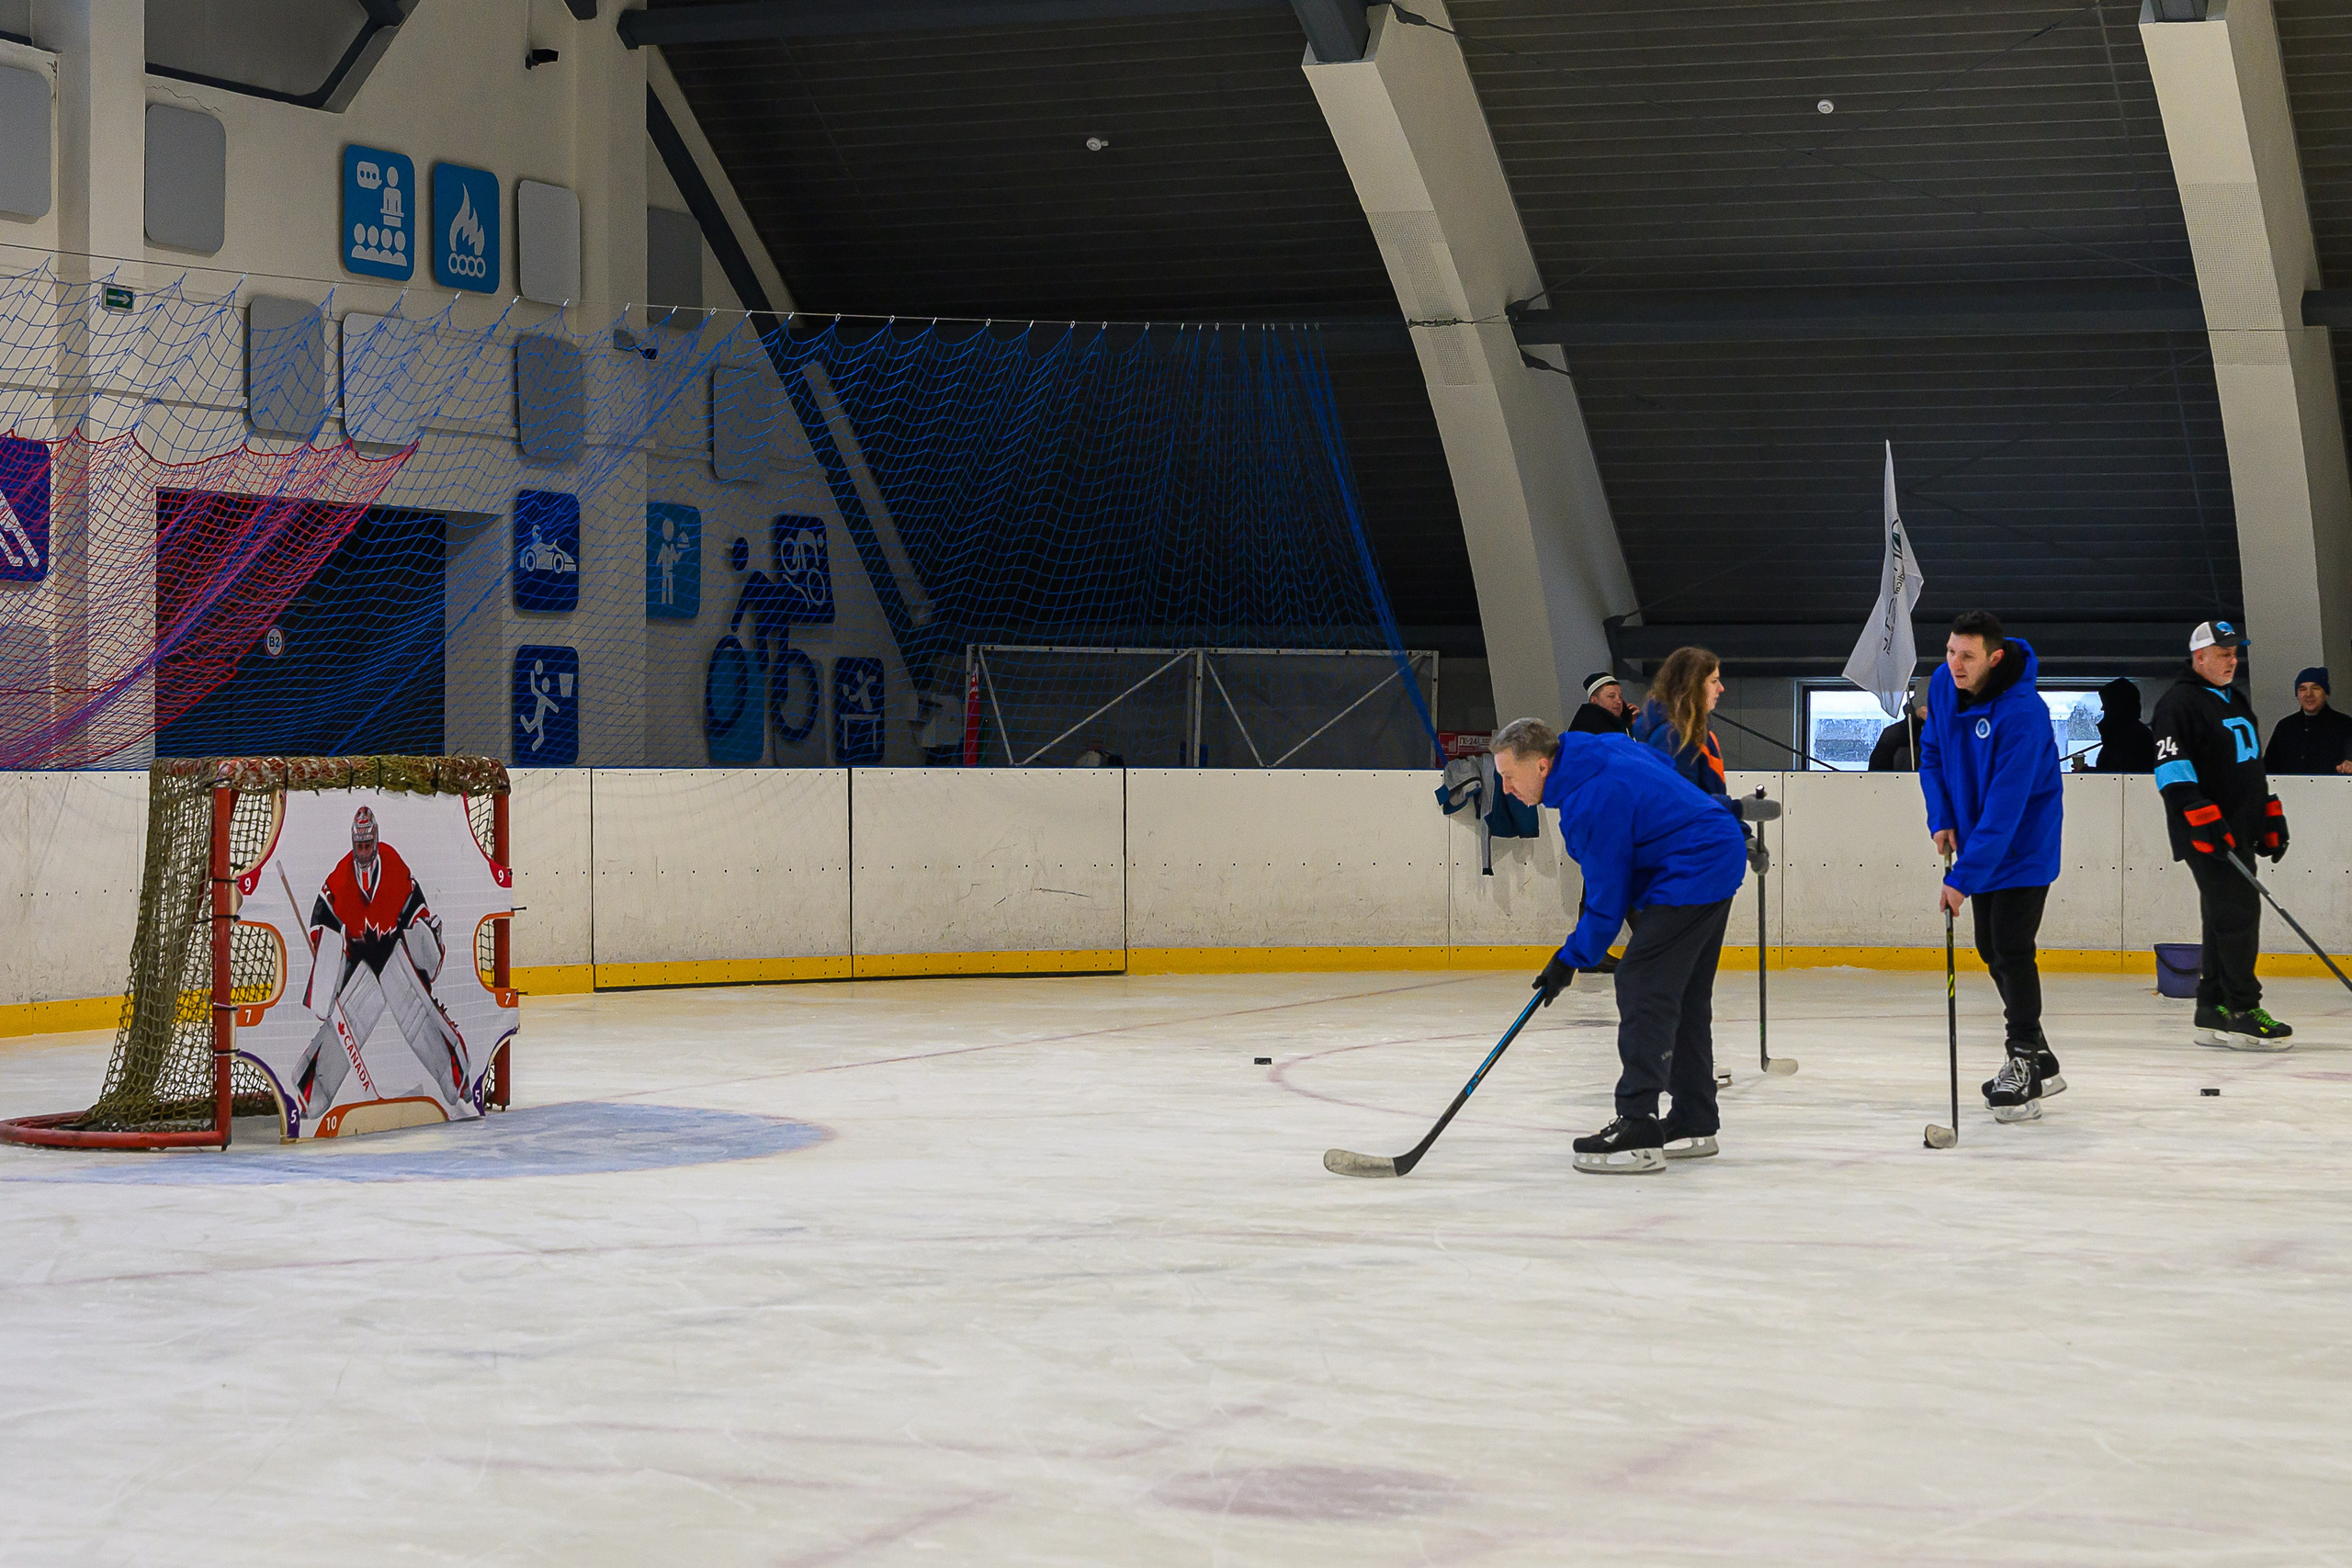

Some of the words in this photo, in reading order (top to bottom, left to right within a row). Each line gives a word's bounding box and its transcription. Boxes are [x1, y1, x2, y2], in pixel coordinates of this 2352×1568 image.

[2155, 736, 2179, 761] 24
[498, 869, 504, 883] 9
[243, 876, 252, 892] 9
[505, 992, 512, 1005] 7
[244, 1009, 253, 1023] 7
[344, 1034, 370, 1093] CANADA
[474, 1089, 481, 1103] 5
[290, 1109, 298, 1124] 5
[326, 1115, 337, 1132] 10
